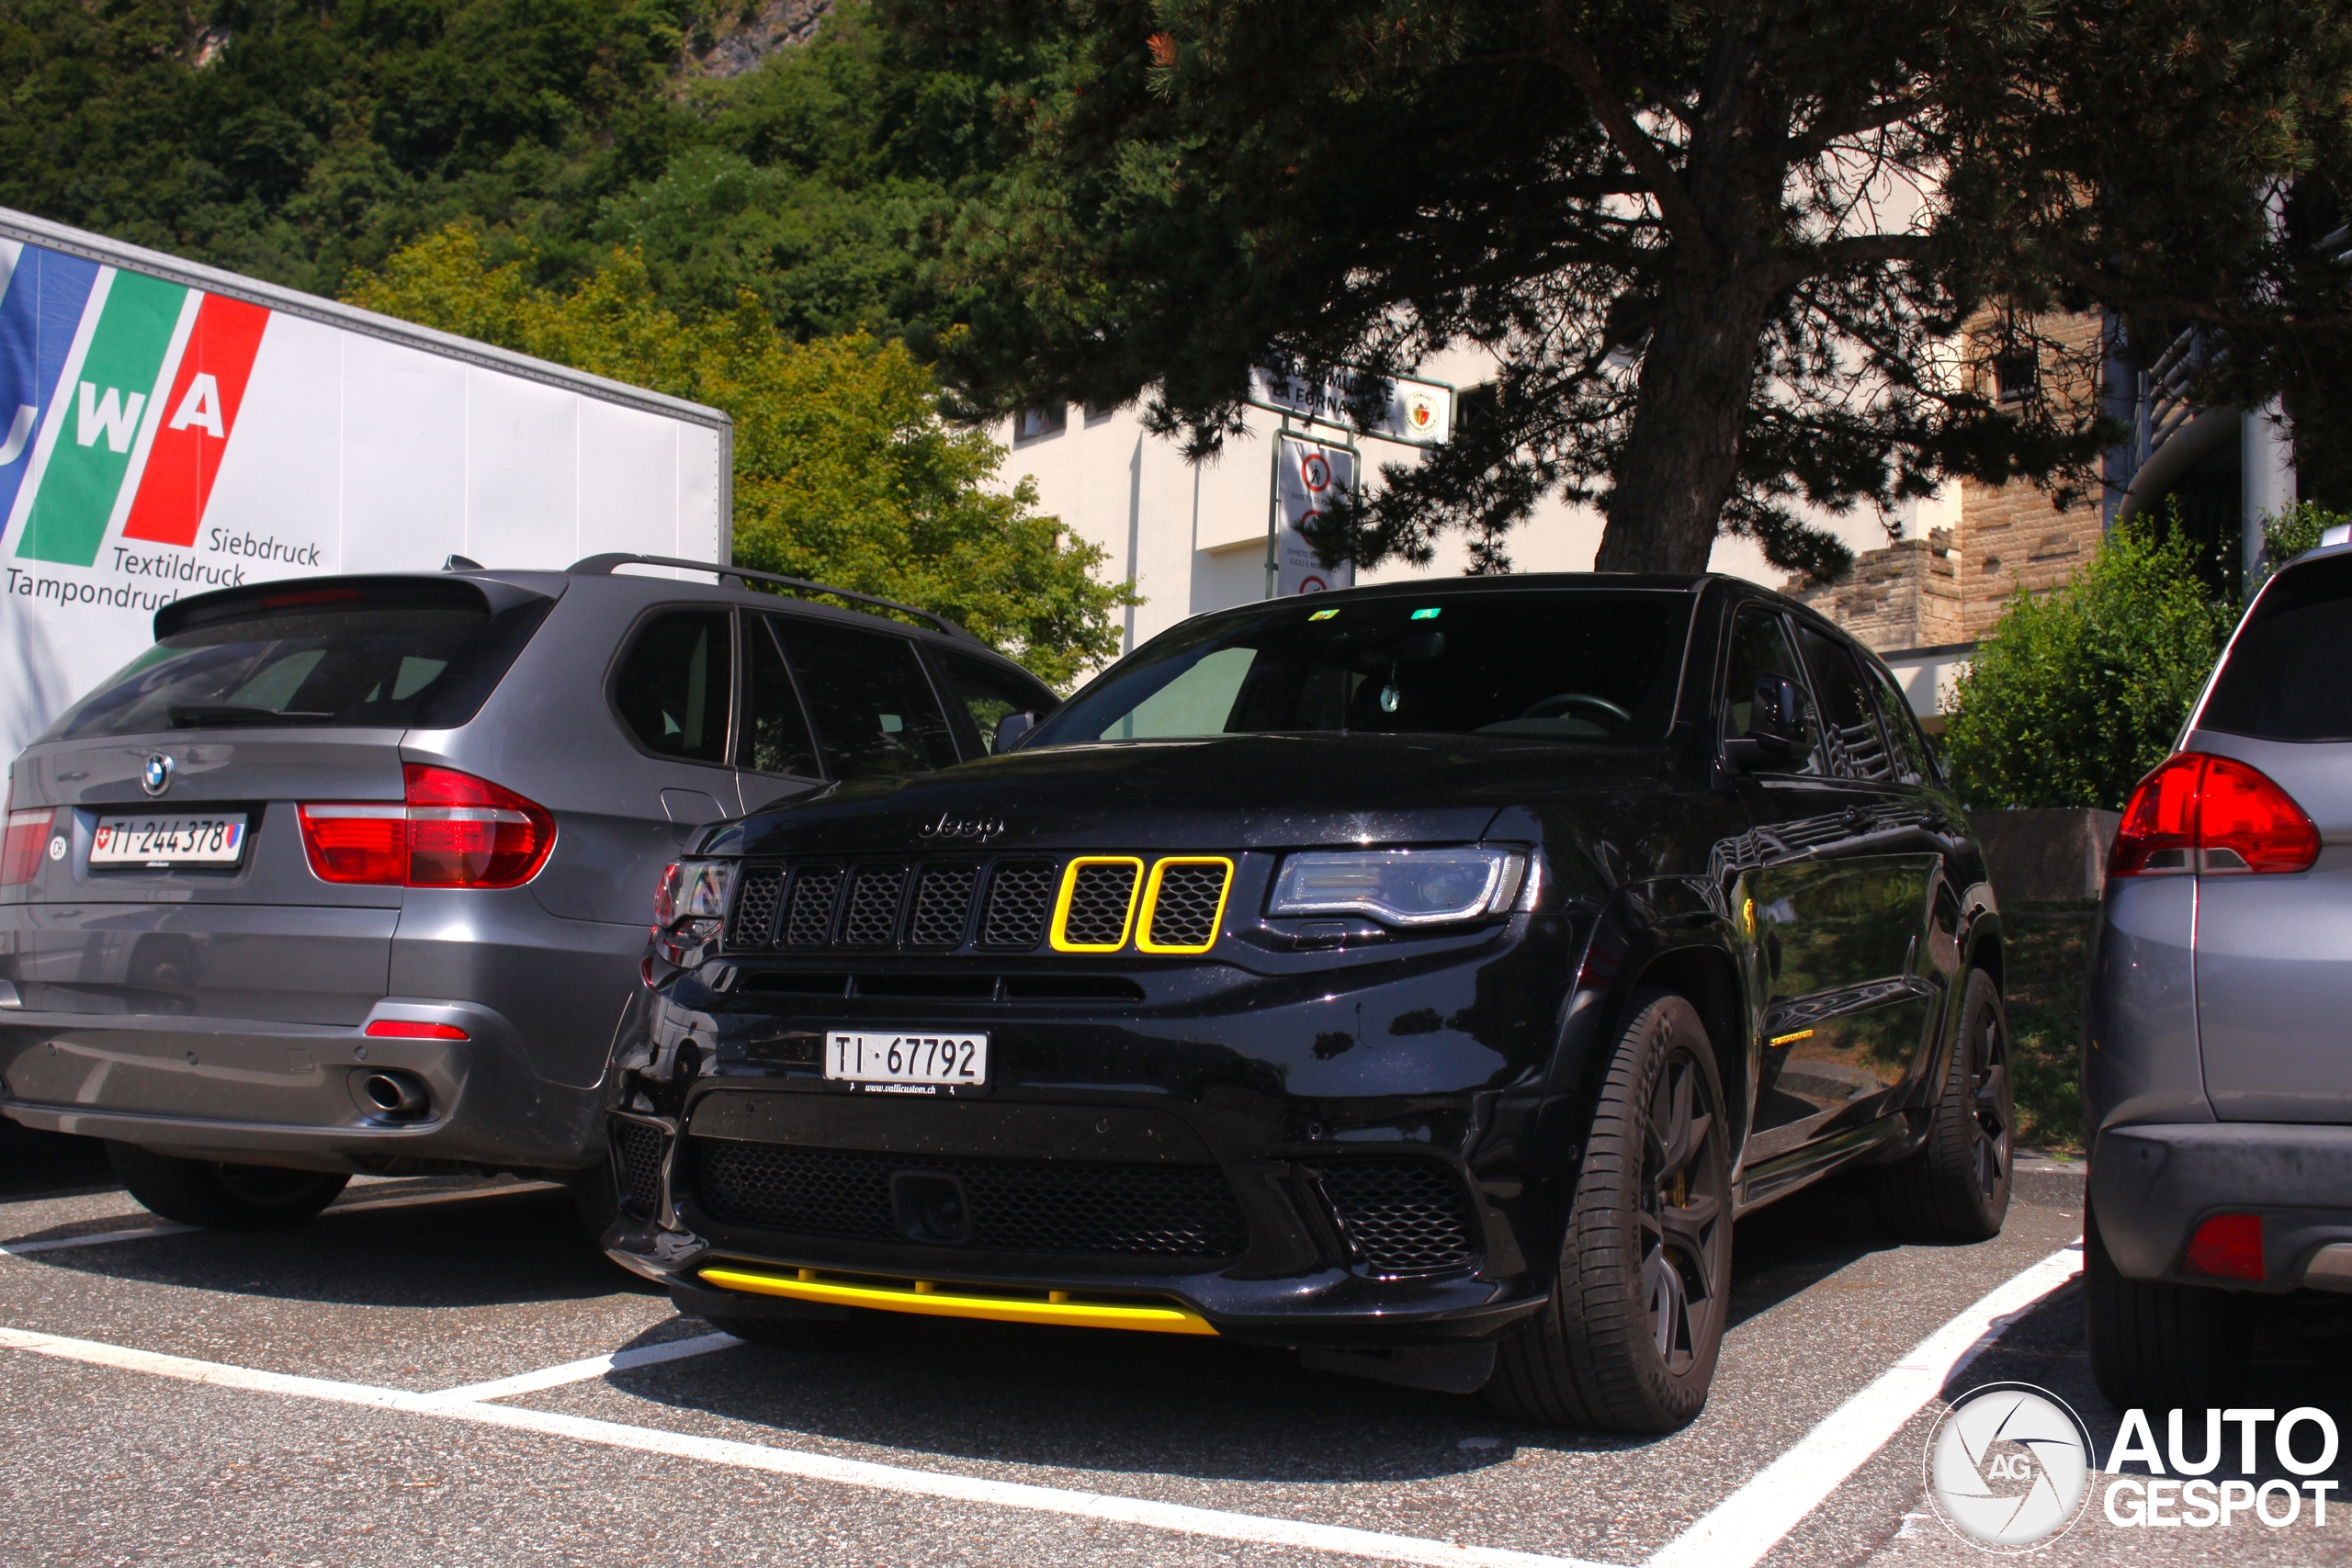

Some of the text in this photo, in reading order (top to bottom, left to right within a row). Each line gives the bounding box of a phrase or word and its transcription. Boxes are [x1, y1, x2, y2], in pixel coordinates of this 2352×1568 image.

[1413, 393, 1431, 401] COMUNE
[1291, 491, 1312, 502] DIVIETO
[1314, 496, 1320, 504] DI
[209, 528, 320, 567] Siebdruck
[1287, 547, 1308, 558] DIVIETO
[114, 547, 246, 587] Textildruck
[1290, 558, 1304, 567] CICLI
[919, 812, 1003, 843] Jeep
[53, 840, 63, 855] CH
